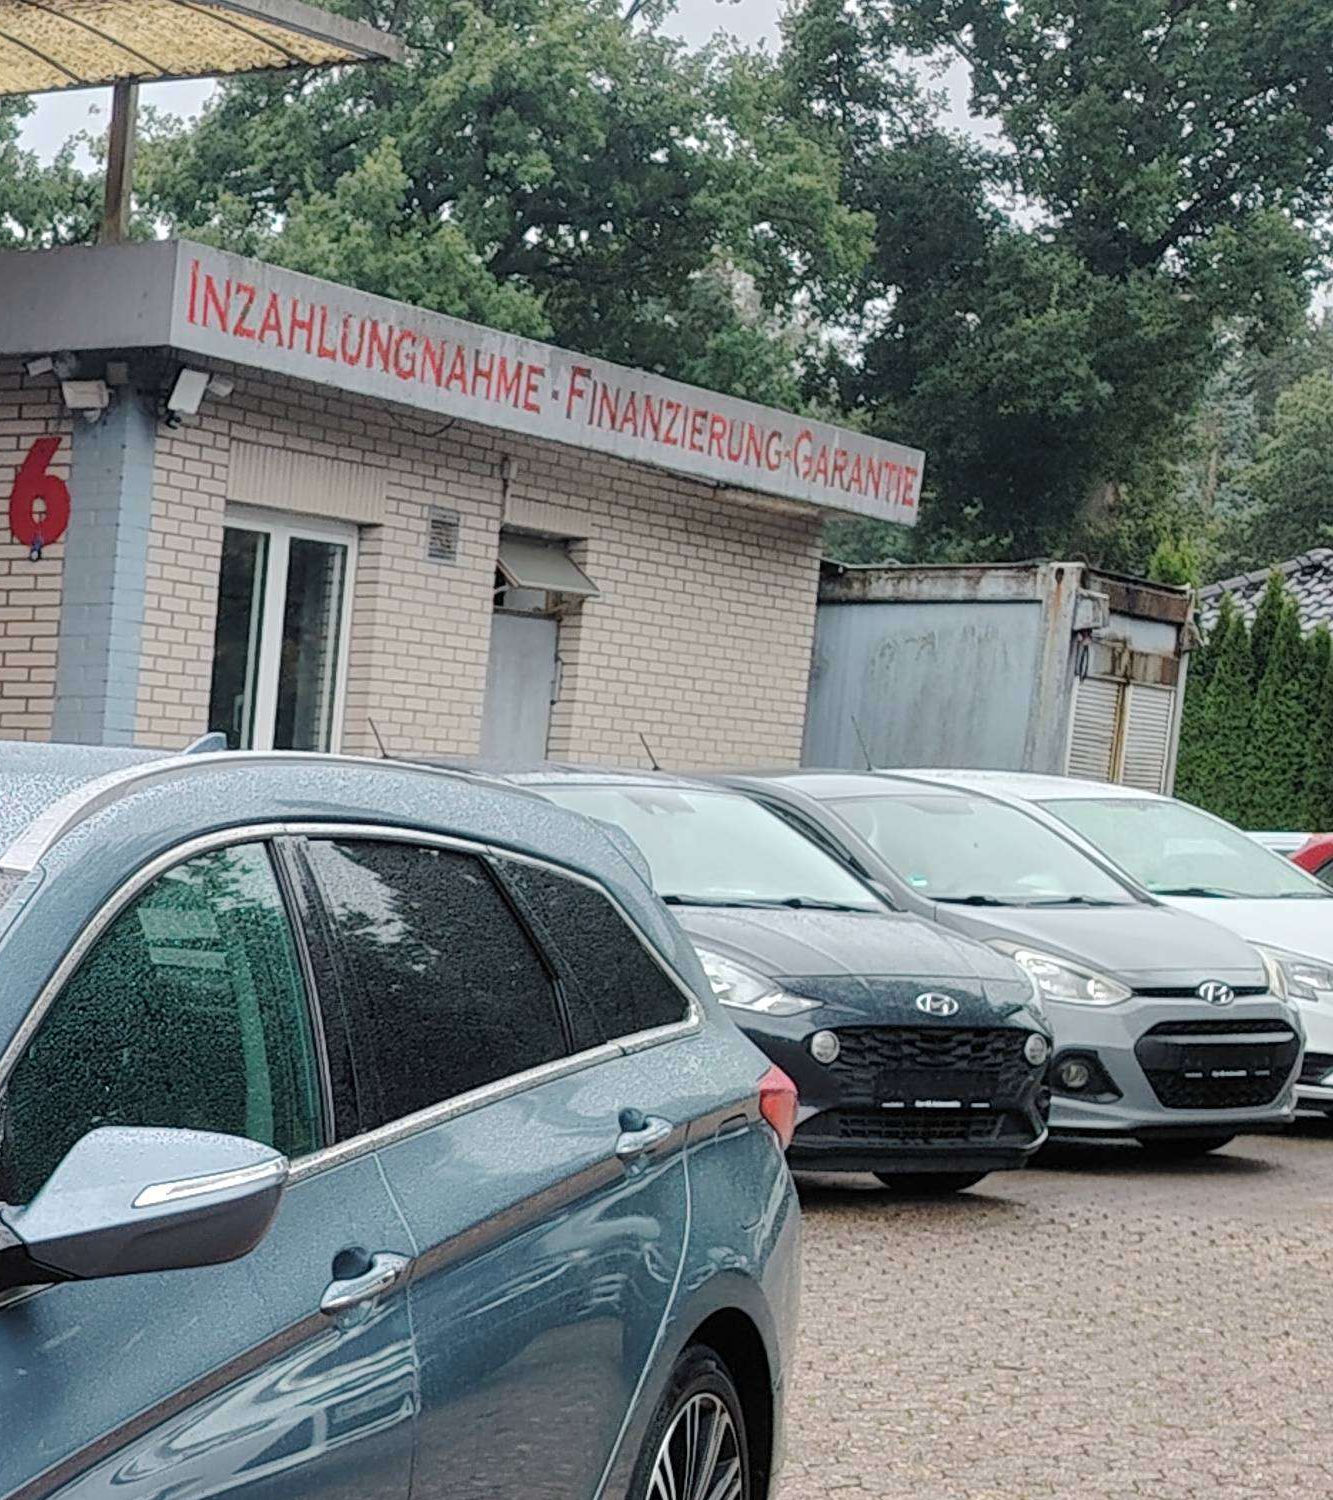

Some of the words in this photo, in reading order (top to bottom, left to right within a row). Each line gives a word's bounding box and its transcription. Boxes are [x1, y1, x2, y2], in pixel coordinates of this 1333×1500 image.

[187, 259, 545, 414] INZAHLUNGNAHME
[565, 365, 783, 472] FINANZIERUNG
[792, 428, 918, 507] GARANTIE
